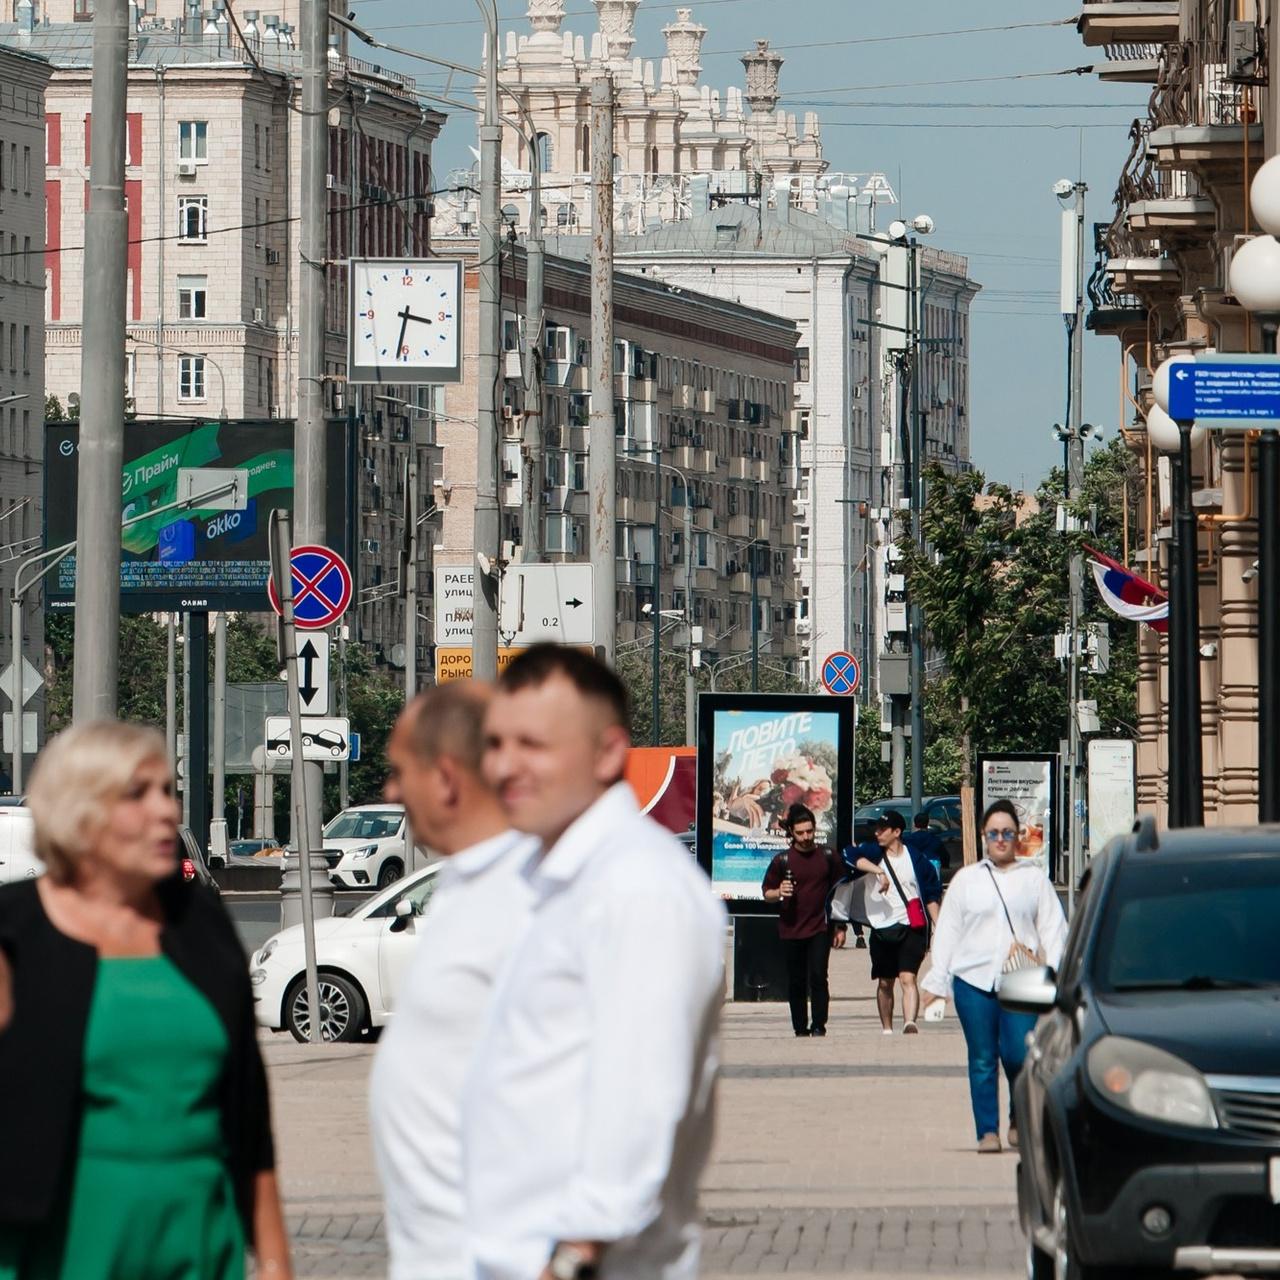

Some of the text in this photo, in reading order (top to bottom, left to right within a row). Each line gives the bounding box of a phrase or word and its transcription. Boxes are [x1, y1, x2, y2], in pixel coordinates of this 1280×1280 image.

[401, 276, 413, 286] 12
[367, 310, 446, 321] 9 3
[401, 345, 410, 355] 6
[133, 453, 180, 486] Прайм
[444, 574, 474, 584] РАЕВ
[444, 589, 473, 598] улиц
[541, 617, 559, 627] 0.2
[444, 627, 473, 637] улиц
[440, 668, 473, 678] РЫНО
[726, 712, 813, 755] ЛОВИТЕ
[738, 738, 797, 774] ЛЕТО
[724, 842, 744, 850] более
[745, 842, 756, 850] 100
